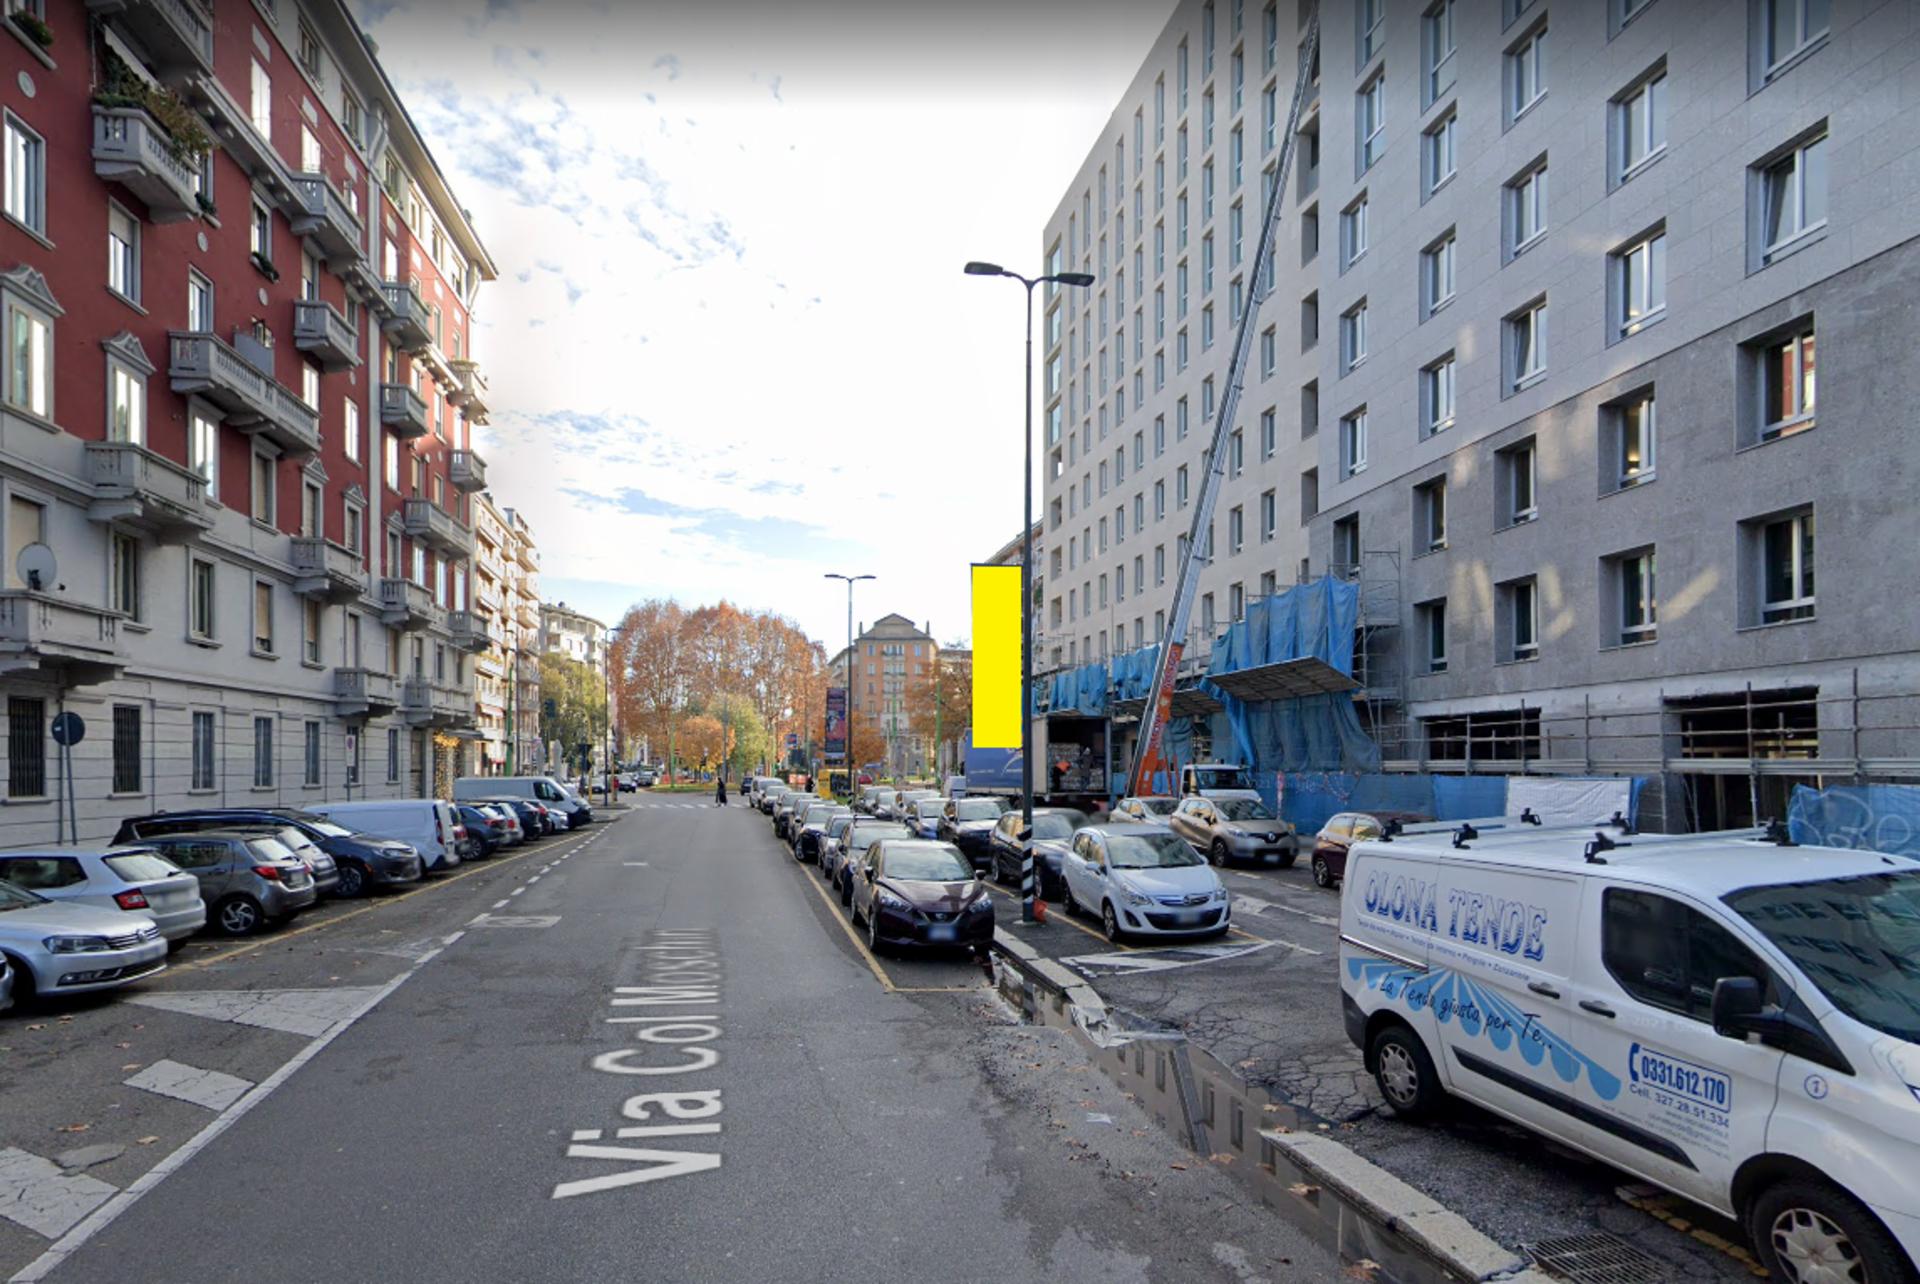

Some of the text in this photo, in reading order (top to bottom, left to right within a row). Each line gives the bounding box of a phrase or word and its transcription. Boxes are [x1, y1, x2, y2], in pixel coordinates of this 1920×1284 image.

[1365, 870, 1438, 932] OLONA
[1449, 888, 1547, 962] TENDE
[1379, 973, 1394, 994] La
[1400, 976, 1435, 1008] Tenda
[1438, 999, 1480, 1024] giusta
[1483, 1013, 1512, 1036] per
[1641, 1056, 1725, 1105] 0331.612.170
